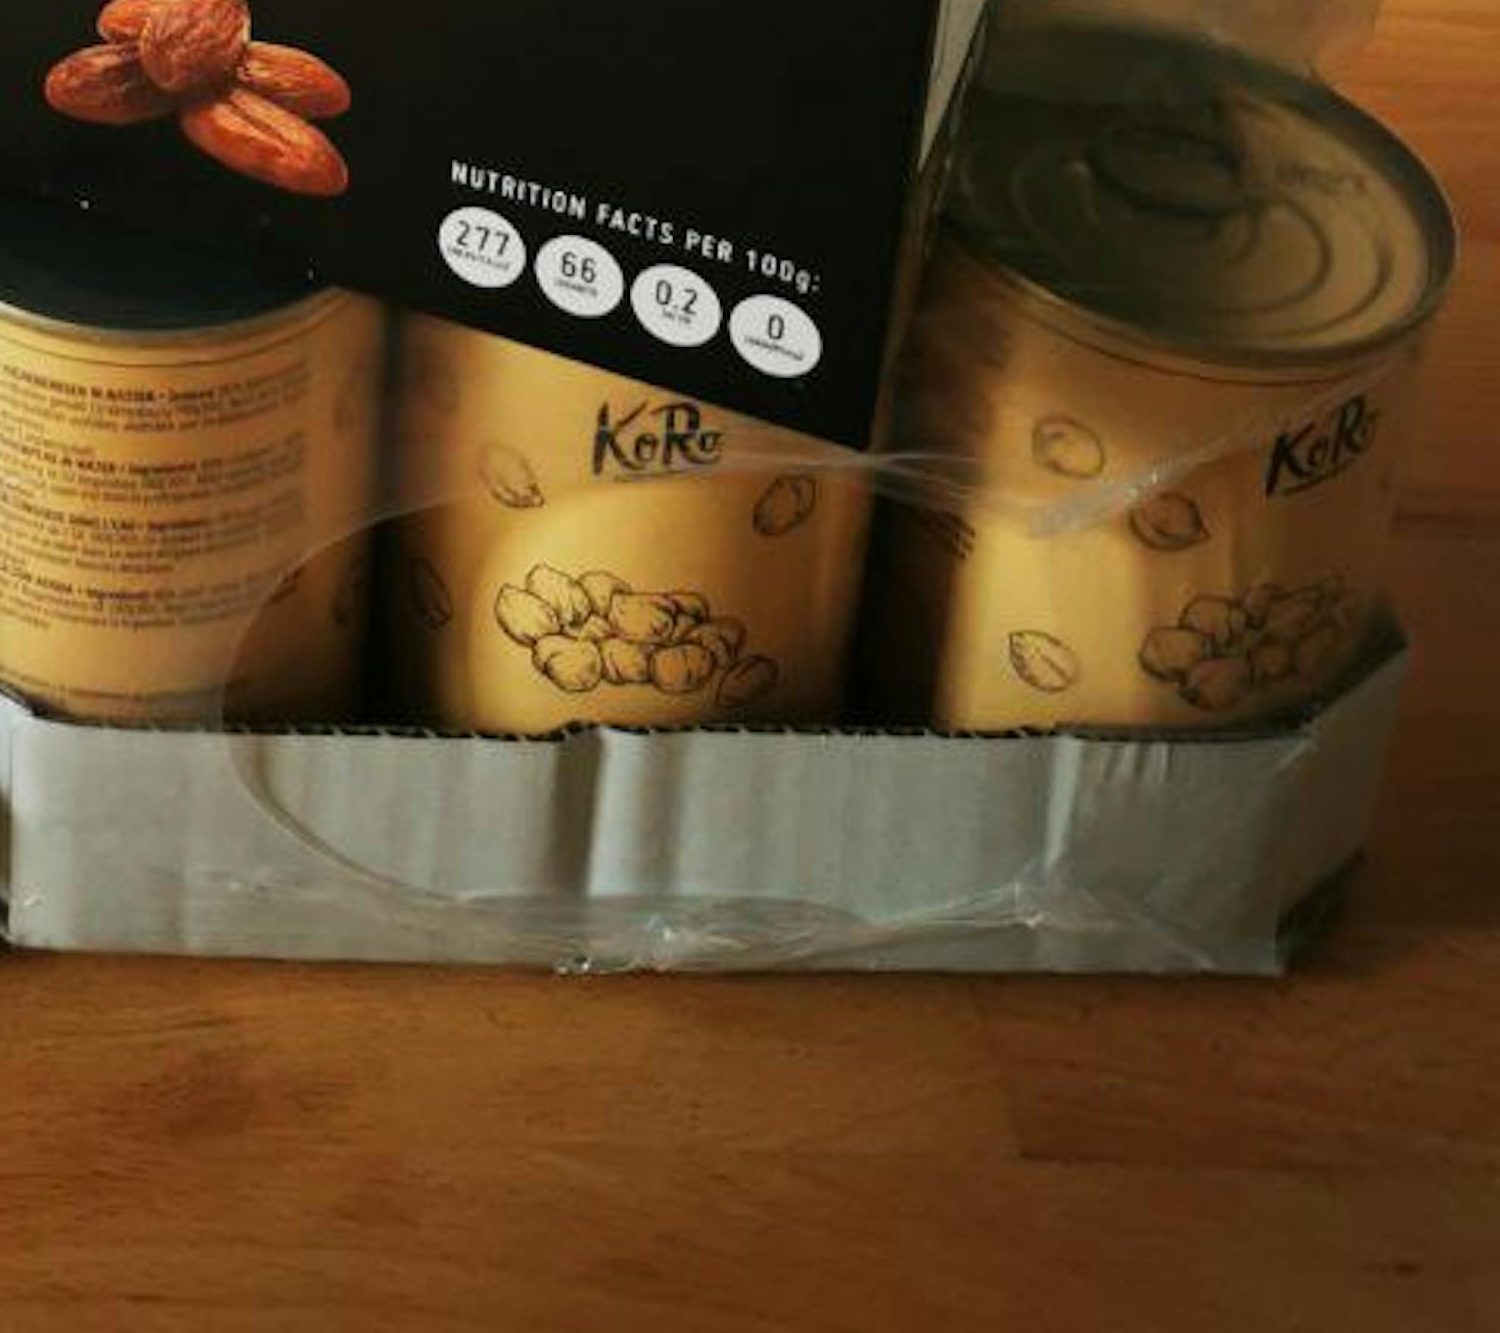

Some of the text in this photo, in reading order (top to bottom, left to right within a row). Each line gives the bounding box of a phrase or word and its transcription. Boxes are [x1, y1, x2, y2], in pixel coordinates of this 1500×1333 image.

[450, 158, 587, 221] NUTRITION
[596, 202, 675, 246] FACTS
[684, 230, 735, 264] PER
[455, 219, 511, 257] 277
[560, 250, 597, 284] 66
[655, 279, 699, 316] 0.2
[767, 314, 786, 341] 0
[592, 399, 727, 484] KoRo
